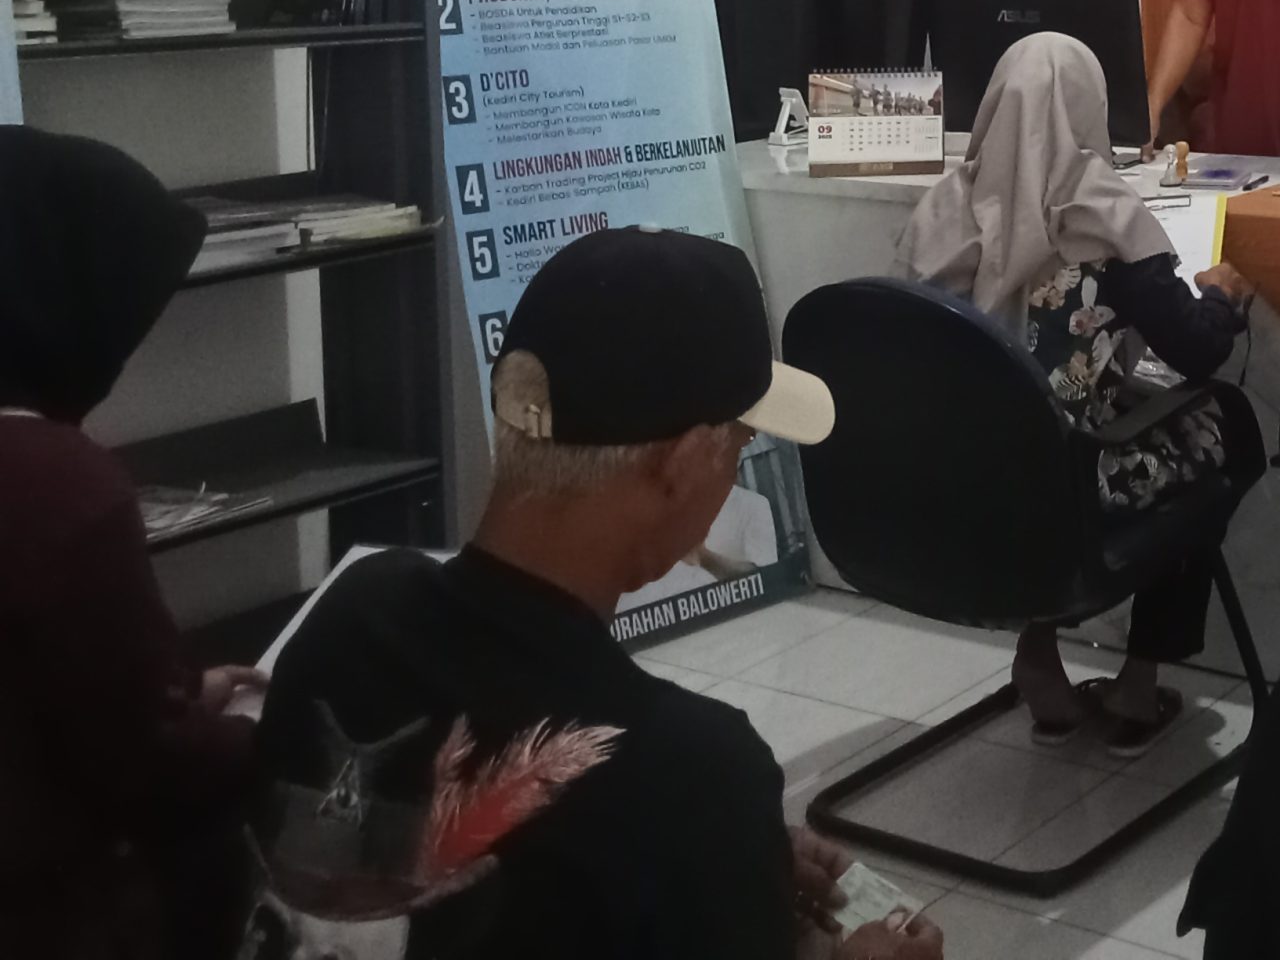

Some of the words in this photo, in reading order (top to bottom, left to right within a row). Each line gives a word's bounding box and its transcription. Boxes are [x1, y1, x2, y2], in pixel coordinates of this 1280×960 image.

[516, 8, 543, 17] Untuk
[562, 42, 580, 50] dan
[480, 69, 530, 92] D'CITO
[449, 81, 469, 119] 3
[483, 94, 517, 107] (Kediri
[519, 91, 540, 103] City
[543, 86, 584, 99] Tourism)
[493, 104, 561, 120] Membangun
[589, 101, 609, 110] Kota
[495, 117, 563, 131] Membangun
[818, 125, 832, 134] 09
[493, 150, 583, 180] LINGKUNGAN
[585, 145, 623, 168] INDAH
[624, 145, 633, 163] &
[635, 134, 726, 162] BERKELANJUTAN
[463, 170, 484, 207] 4
[504, 182, 543, 194] Karbon
[545, 176, 586, 188] Trading
[588, 171, 619, 183] Project
[503, 220, 557, 245] SMART
[560, 211, 609, 236] LIVING
[473, 236, 493, 274] 5
[485, 318, 504, 357] 6
[610, 601, 676, 642] URAHAN
[677, 573, 765, 622] BALOWERTI
